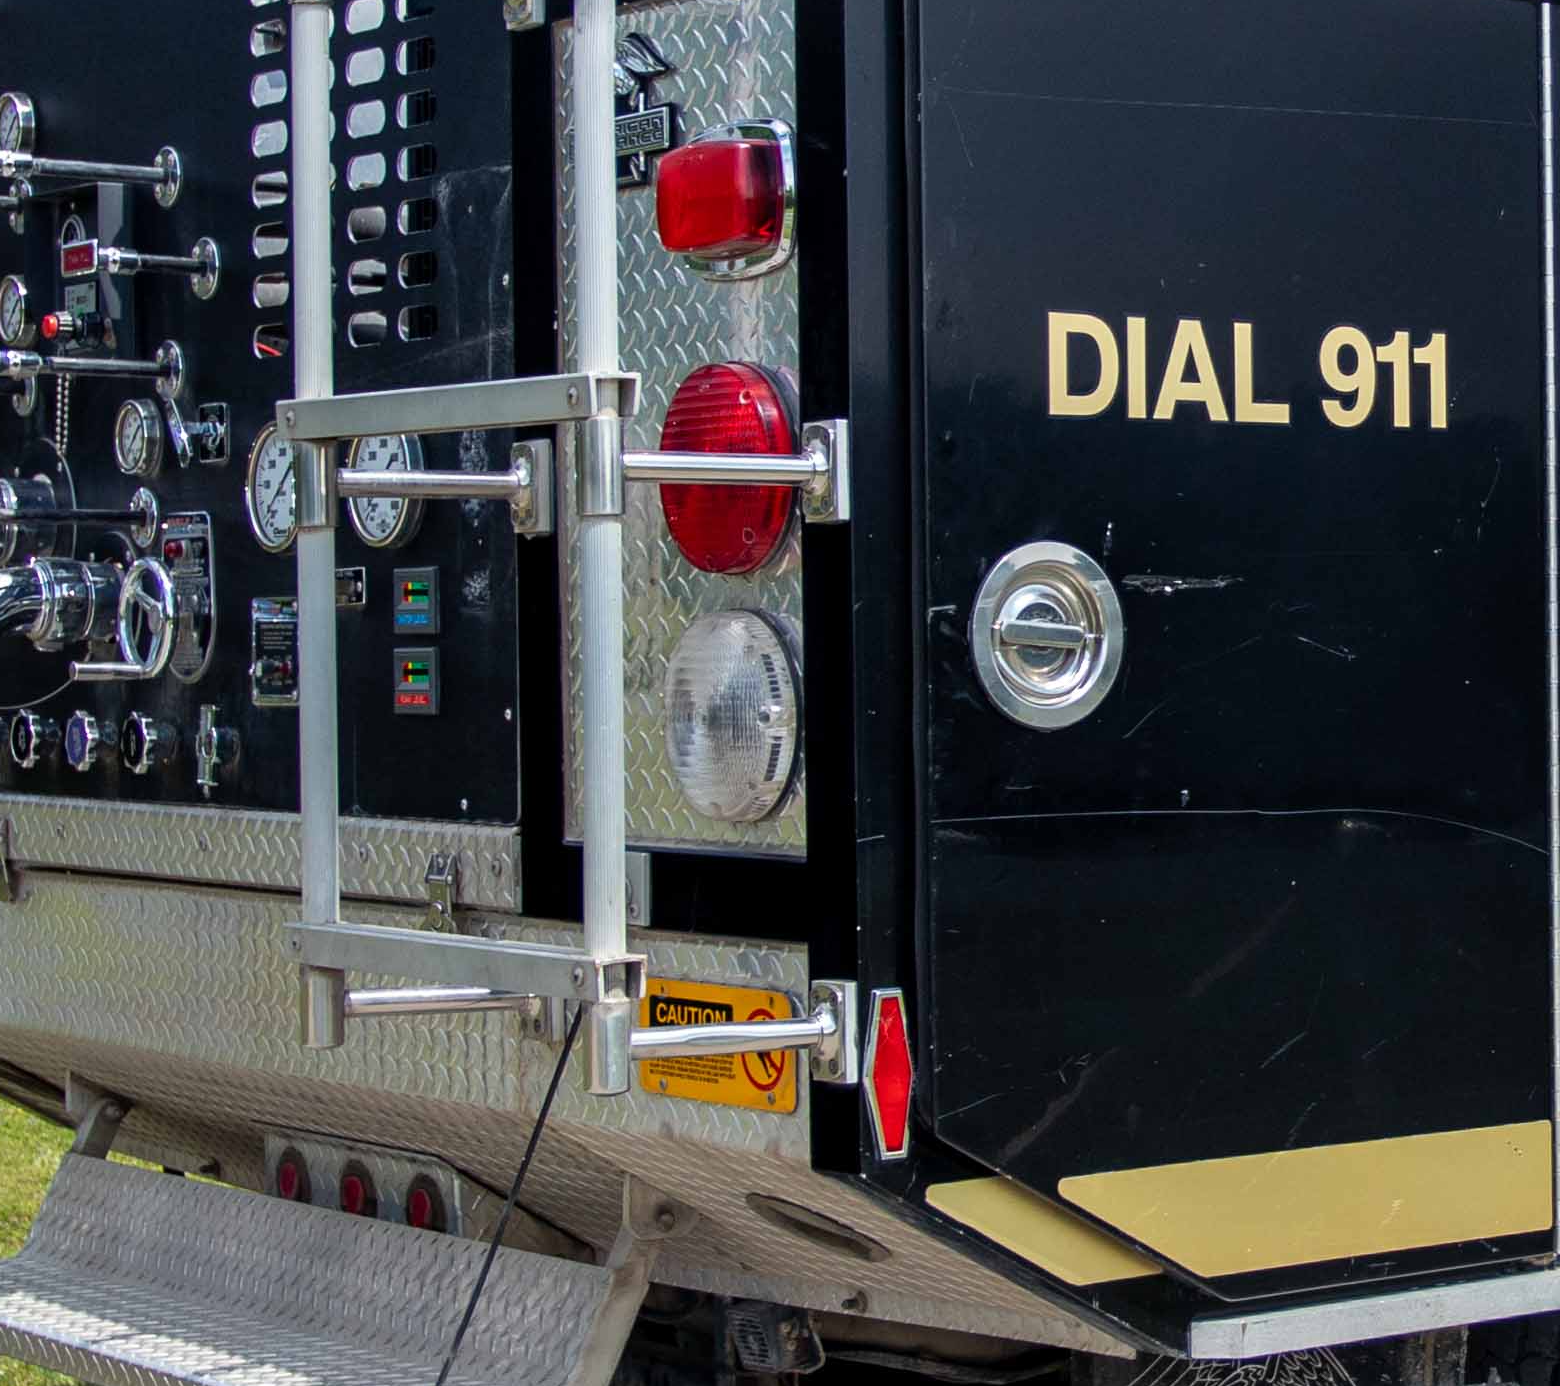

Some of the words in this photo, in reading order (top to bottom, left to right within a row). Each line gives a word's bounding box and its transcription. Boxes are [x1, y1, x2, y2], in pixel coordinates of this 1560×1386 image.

[1048, 311, 1290, 424] DIAL
[1319, 326, 1447, 429] 911
[656, 1002, 726, 1025] CAUTION
